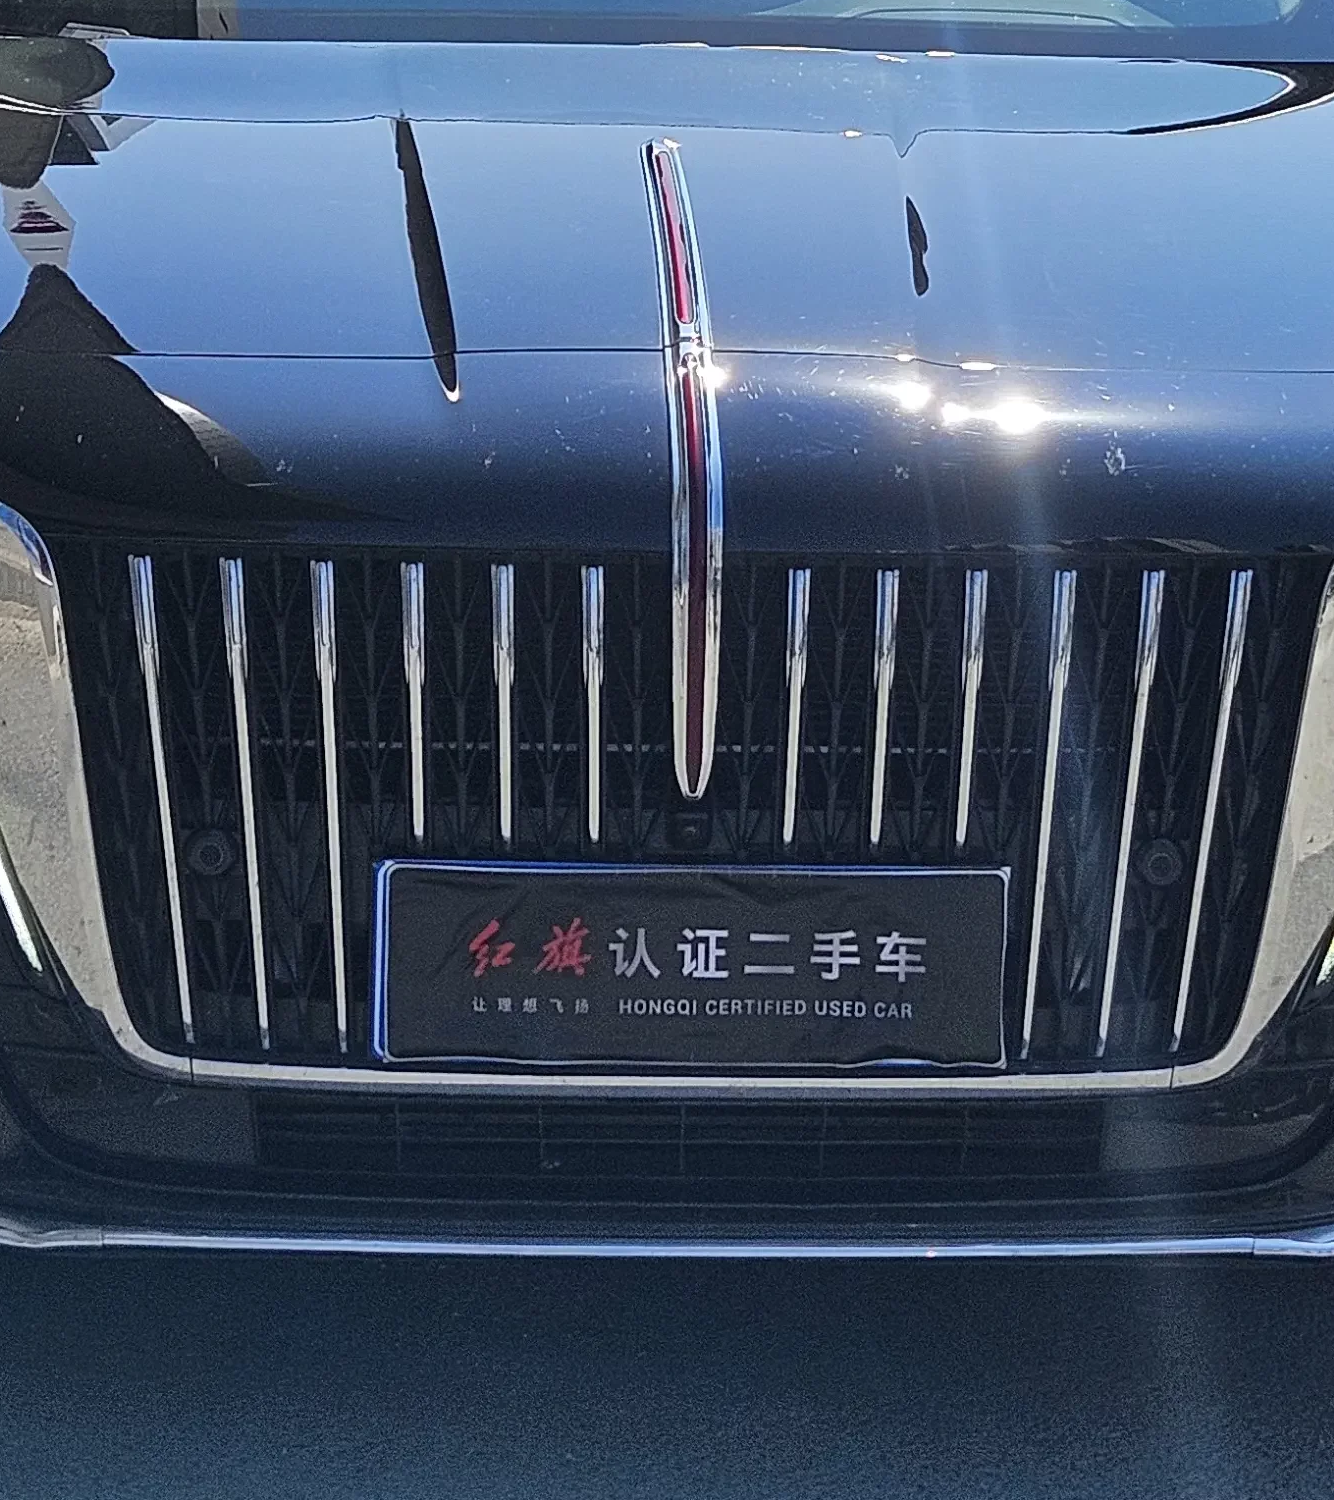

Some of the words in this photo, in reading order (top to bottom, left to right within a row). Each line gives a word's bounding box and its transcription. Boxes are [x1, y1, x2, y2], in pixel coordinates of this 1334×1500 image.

[472, 996, 590, 1014] 让理想飞扬
[618, 999, 697, 1016] HONGQI
[705, 999, 807, 1016] CERTIFIED
[814, 1000, 867, 1018] USED
[873, 1002, 913, 1018] CAR
